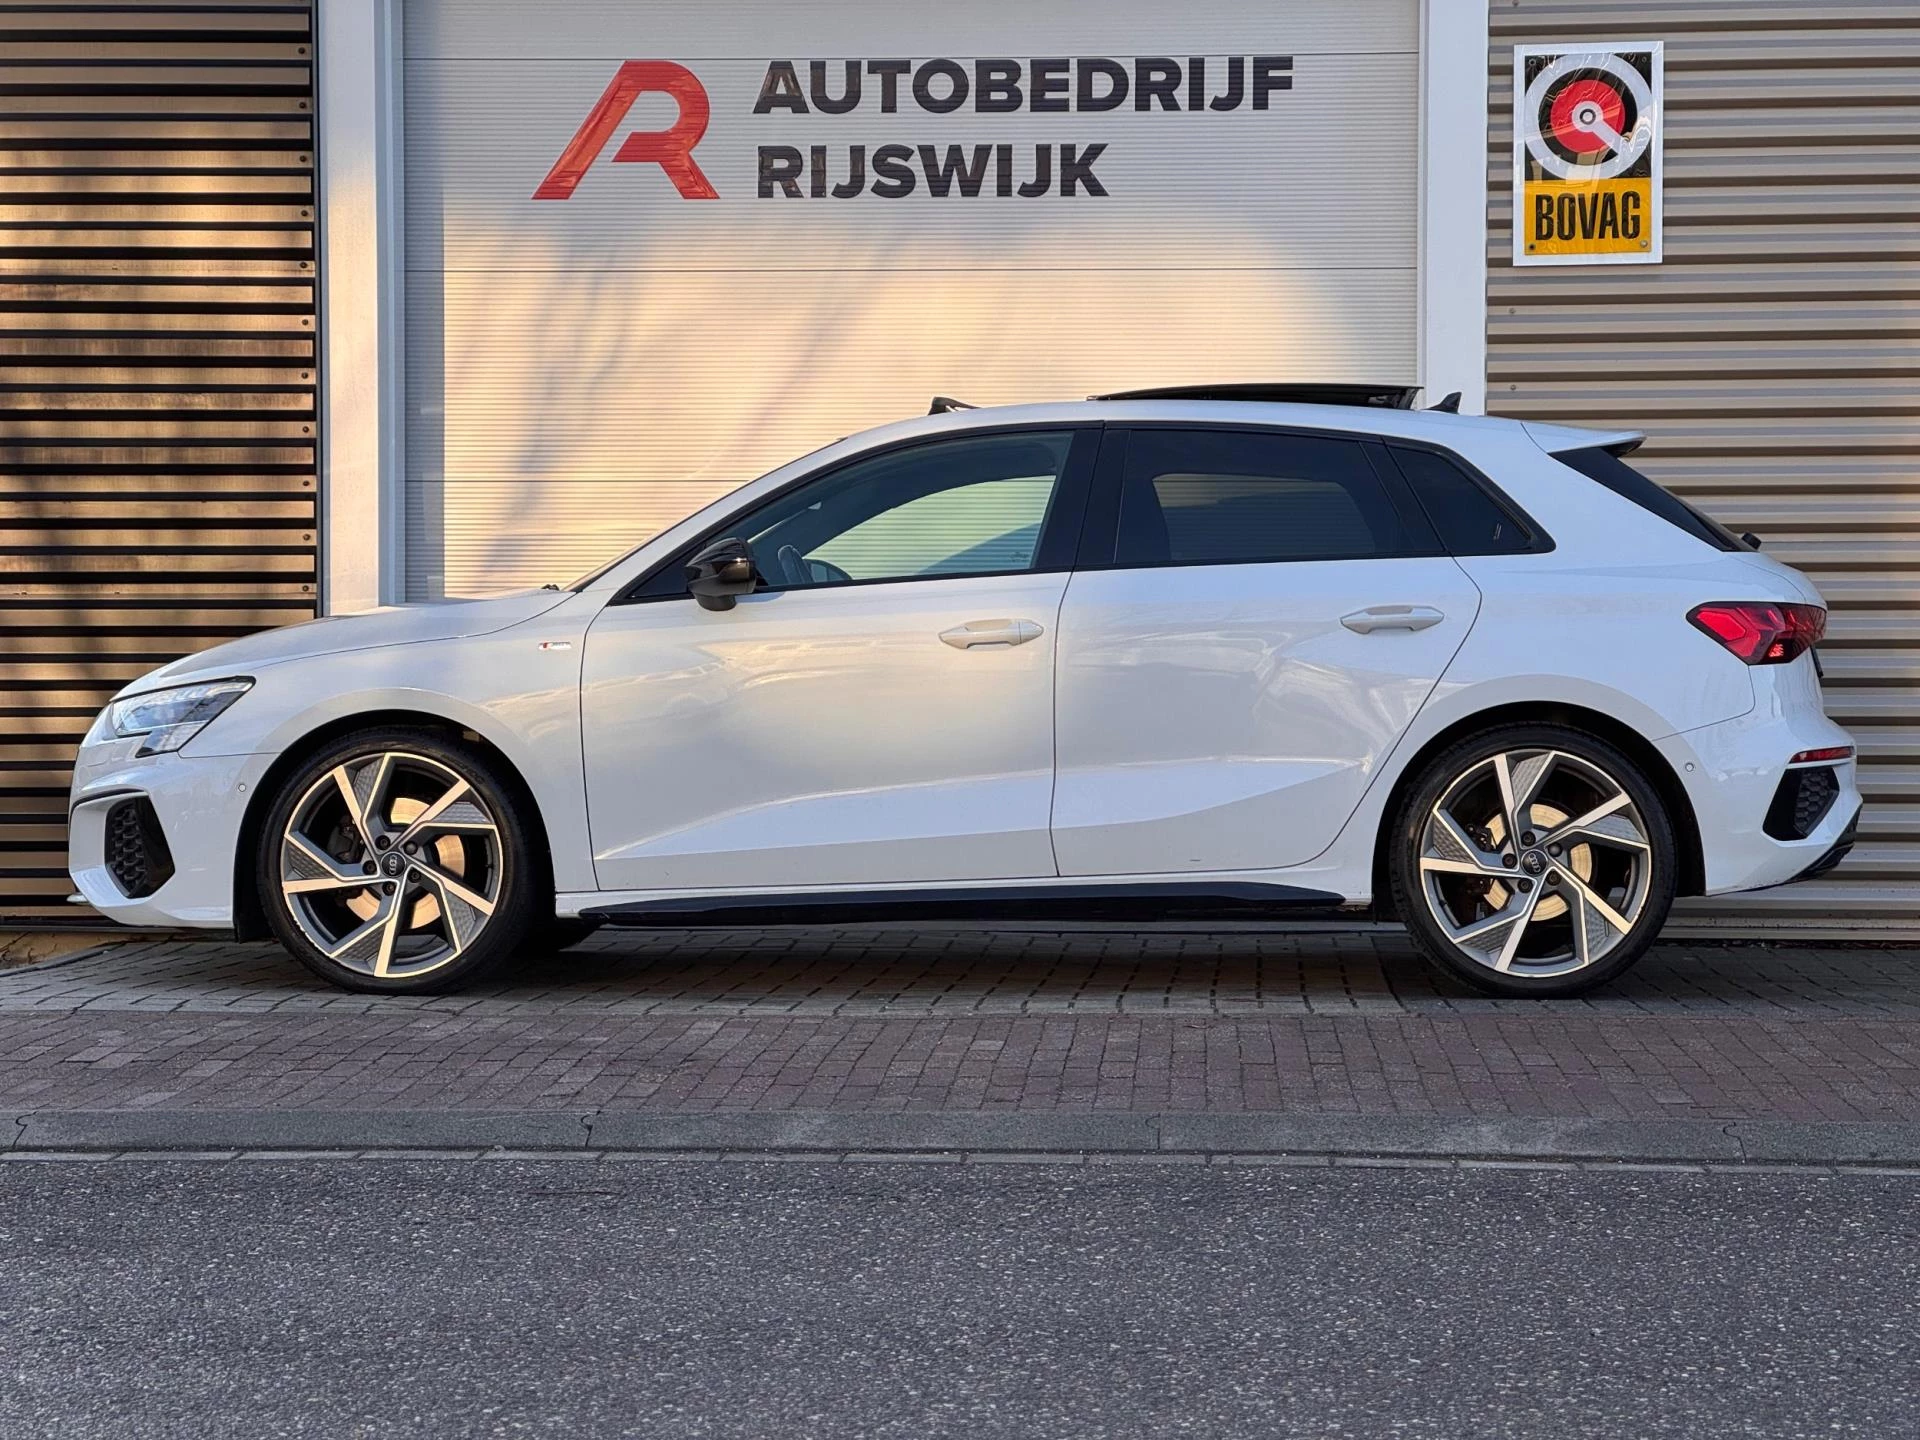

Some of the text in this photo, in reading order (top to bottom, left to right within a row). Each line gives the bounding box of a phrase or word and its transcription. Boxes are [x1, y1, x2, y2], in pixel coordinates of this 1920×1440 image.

[753, 56, 1294, 115] AUTOBEDRIJF
[757, 144, 1109, 199] RIJSWIJK
[1535, 191, 1641, 241] BOVAG
